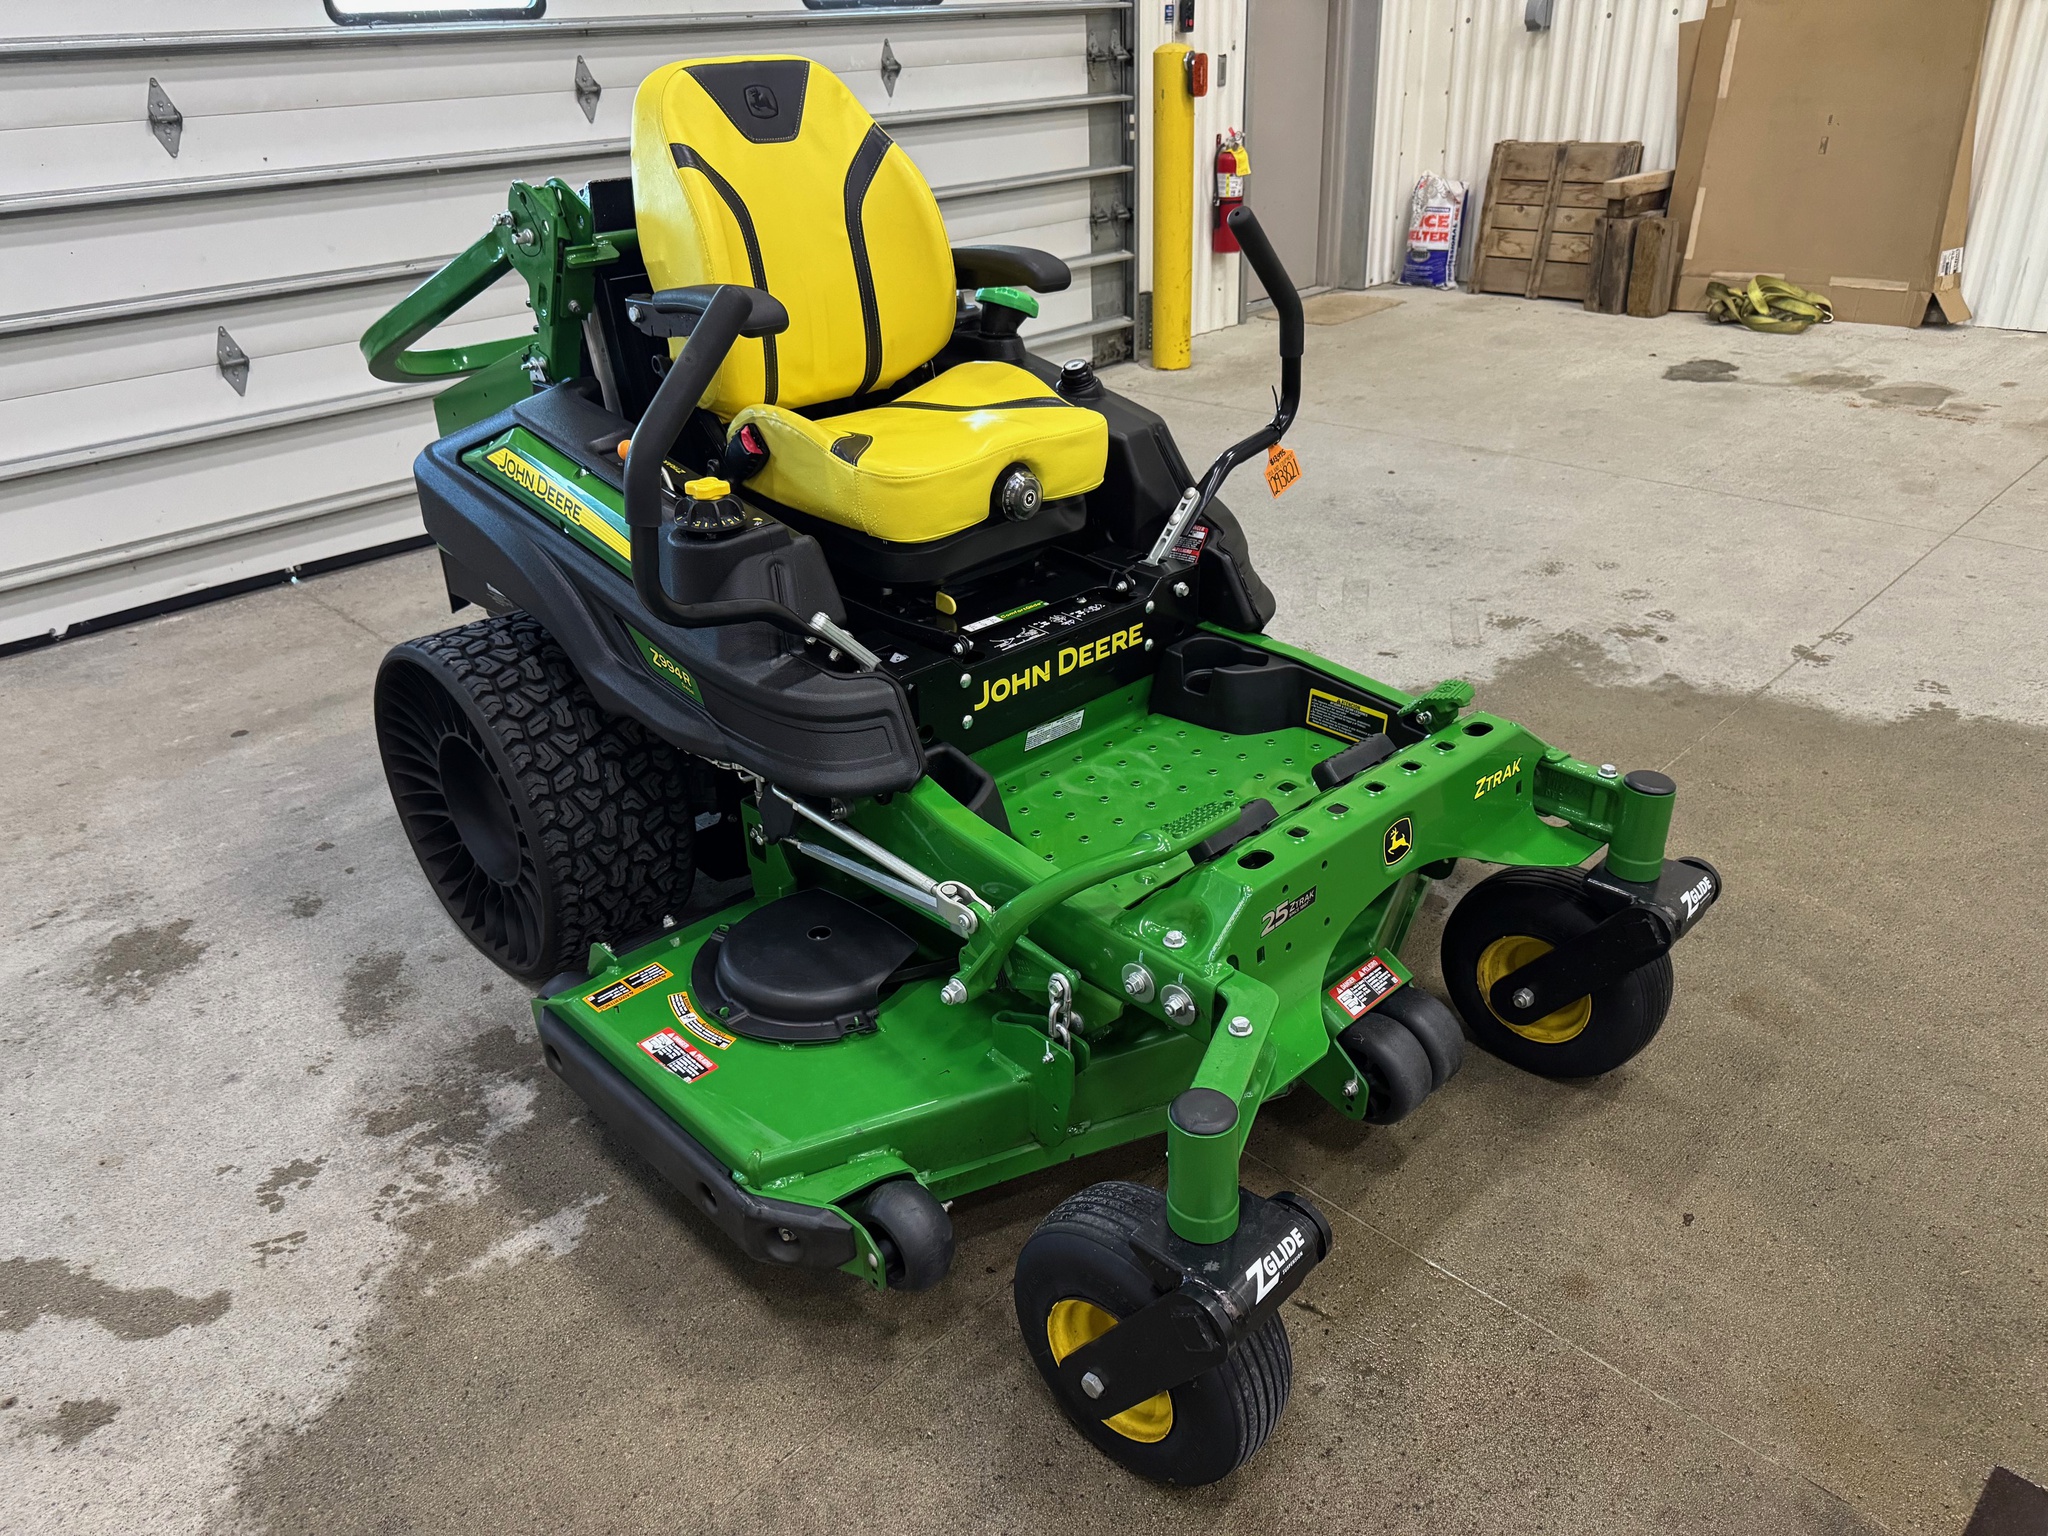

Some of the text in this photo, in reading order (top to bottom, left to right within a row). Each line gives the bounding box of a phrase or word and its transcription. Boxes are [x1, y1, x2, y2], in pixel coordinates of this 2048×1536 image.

[1408, 231, 1449, 243] ELTER
[1418, 214, 1449, 229] ICE
[498, 452, 582, 522] JOHN DEERE
[649, 647, 691, 687] Z994R
[974, 660, 1050, 711] JOHN
[1058, 623, 1143, 677] DEERE
[1474, 757, 1522, 800] ZTRAK
[1261, 890, 1314, 938] 25 ZTRAK
[1680, 876, 1713, 922] ZGLIDE
[1341, 960, 1378, 991] DANGER PELIGRO
[673, 1035, 713, 1067] DANGER PELIGRO
[1245, 1227, 1305, 1305] ZGLIDE
